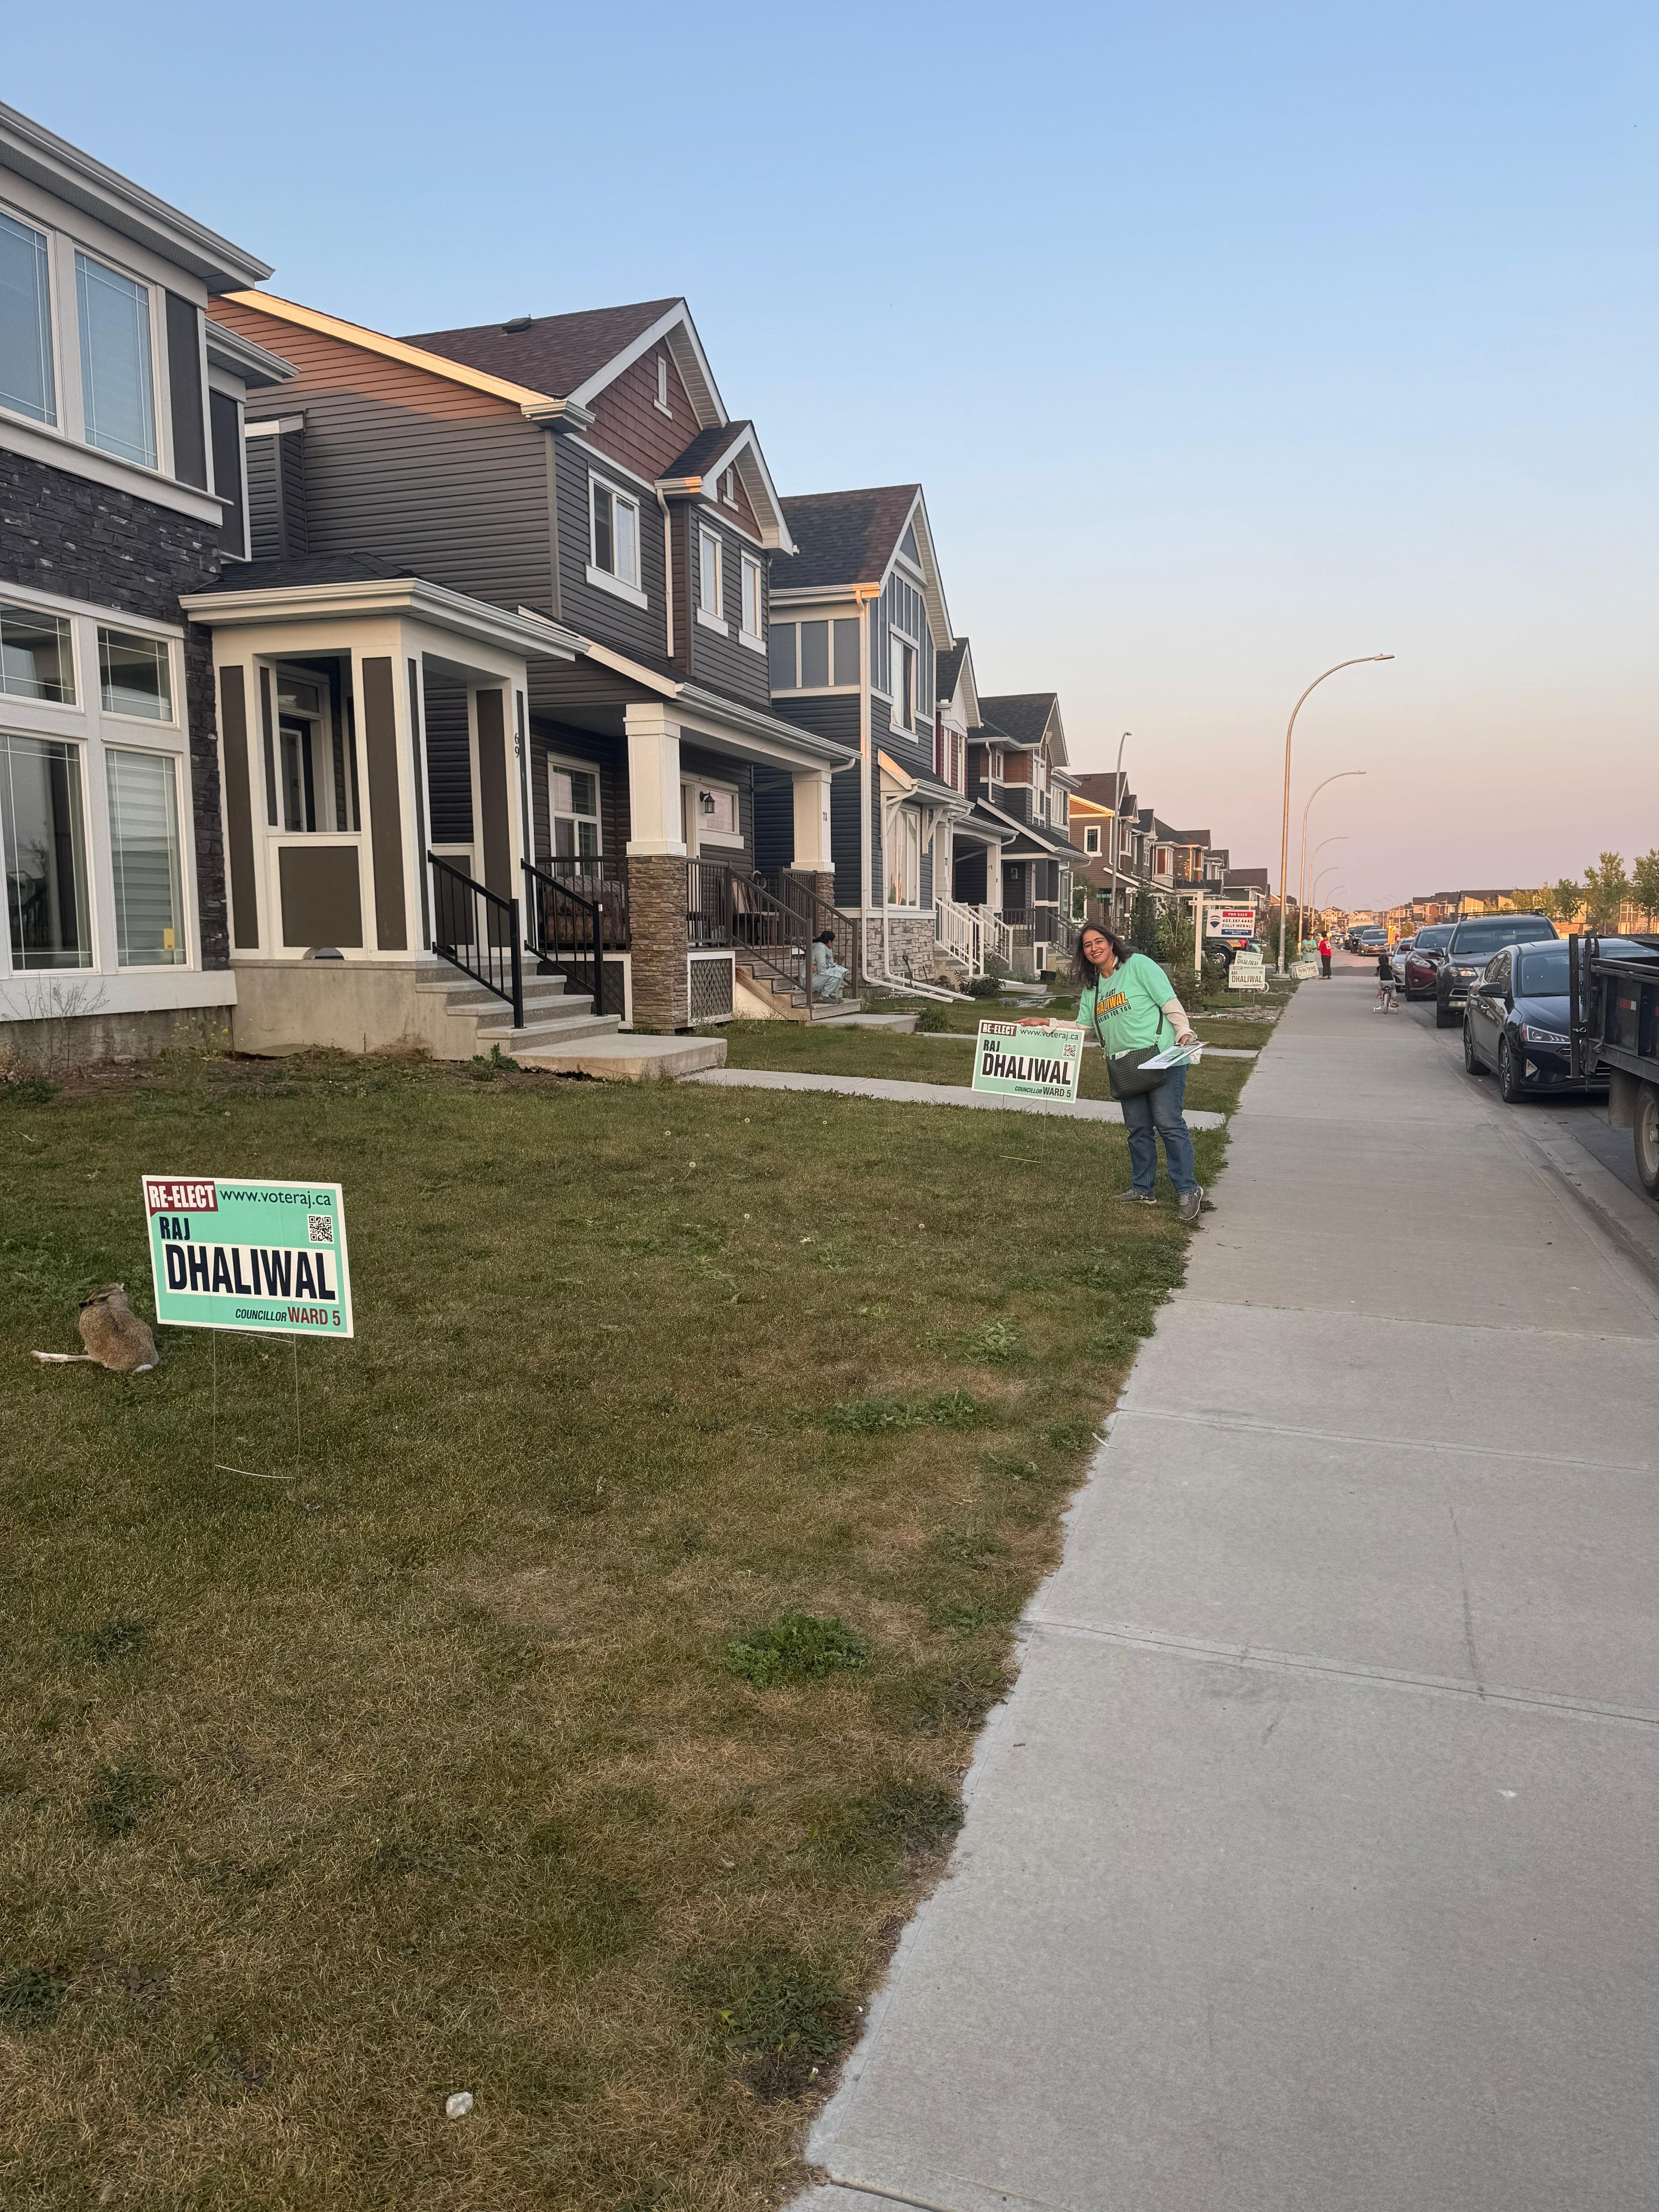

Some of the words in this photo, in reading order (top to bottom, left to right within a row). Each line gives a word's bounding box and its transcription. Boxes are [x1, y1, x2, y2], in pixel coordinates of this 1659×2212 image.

[1096, 992, 1128, 1015] HALIWAL
[982, 1024, 1015, 1035] RE-ELECT
[983, 1039, 1001, 1052] RAJ
[982, 1053, 1071, 1085] DHALIWAL
[1014, 1086, 1043, 1094] COUNCILLOR
[1042, 1086, 1064, 1097] WARD
[1066, 1090, 1071, 1098] 5
[148, 1185, 214, 1208] RE-ELECT
[219, 1190, 332, 1209] www.voteraj.ca
[159, 1216, 191, 1240] RAJ
[165, 1244, 336, 1300] DHALIWAL
[235, 1309, 287, 1322] COUNCILLOR
[287, 1306, 328, 1325] WARD
[332, 1310, 341, 1326] 5
